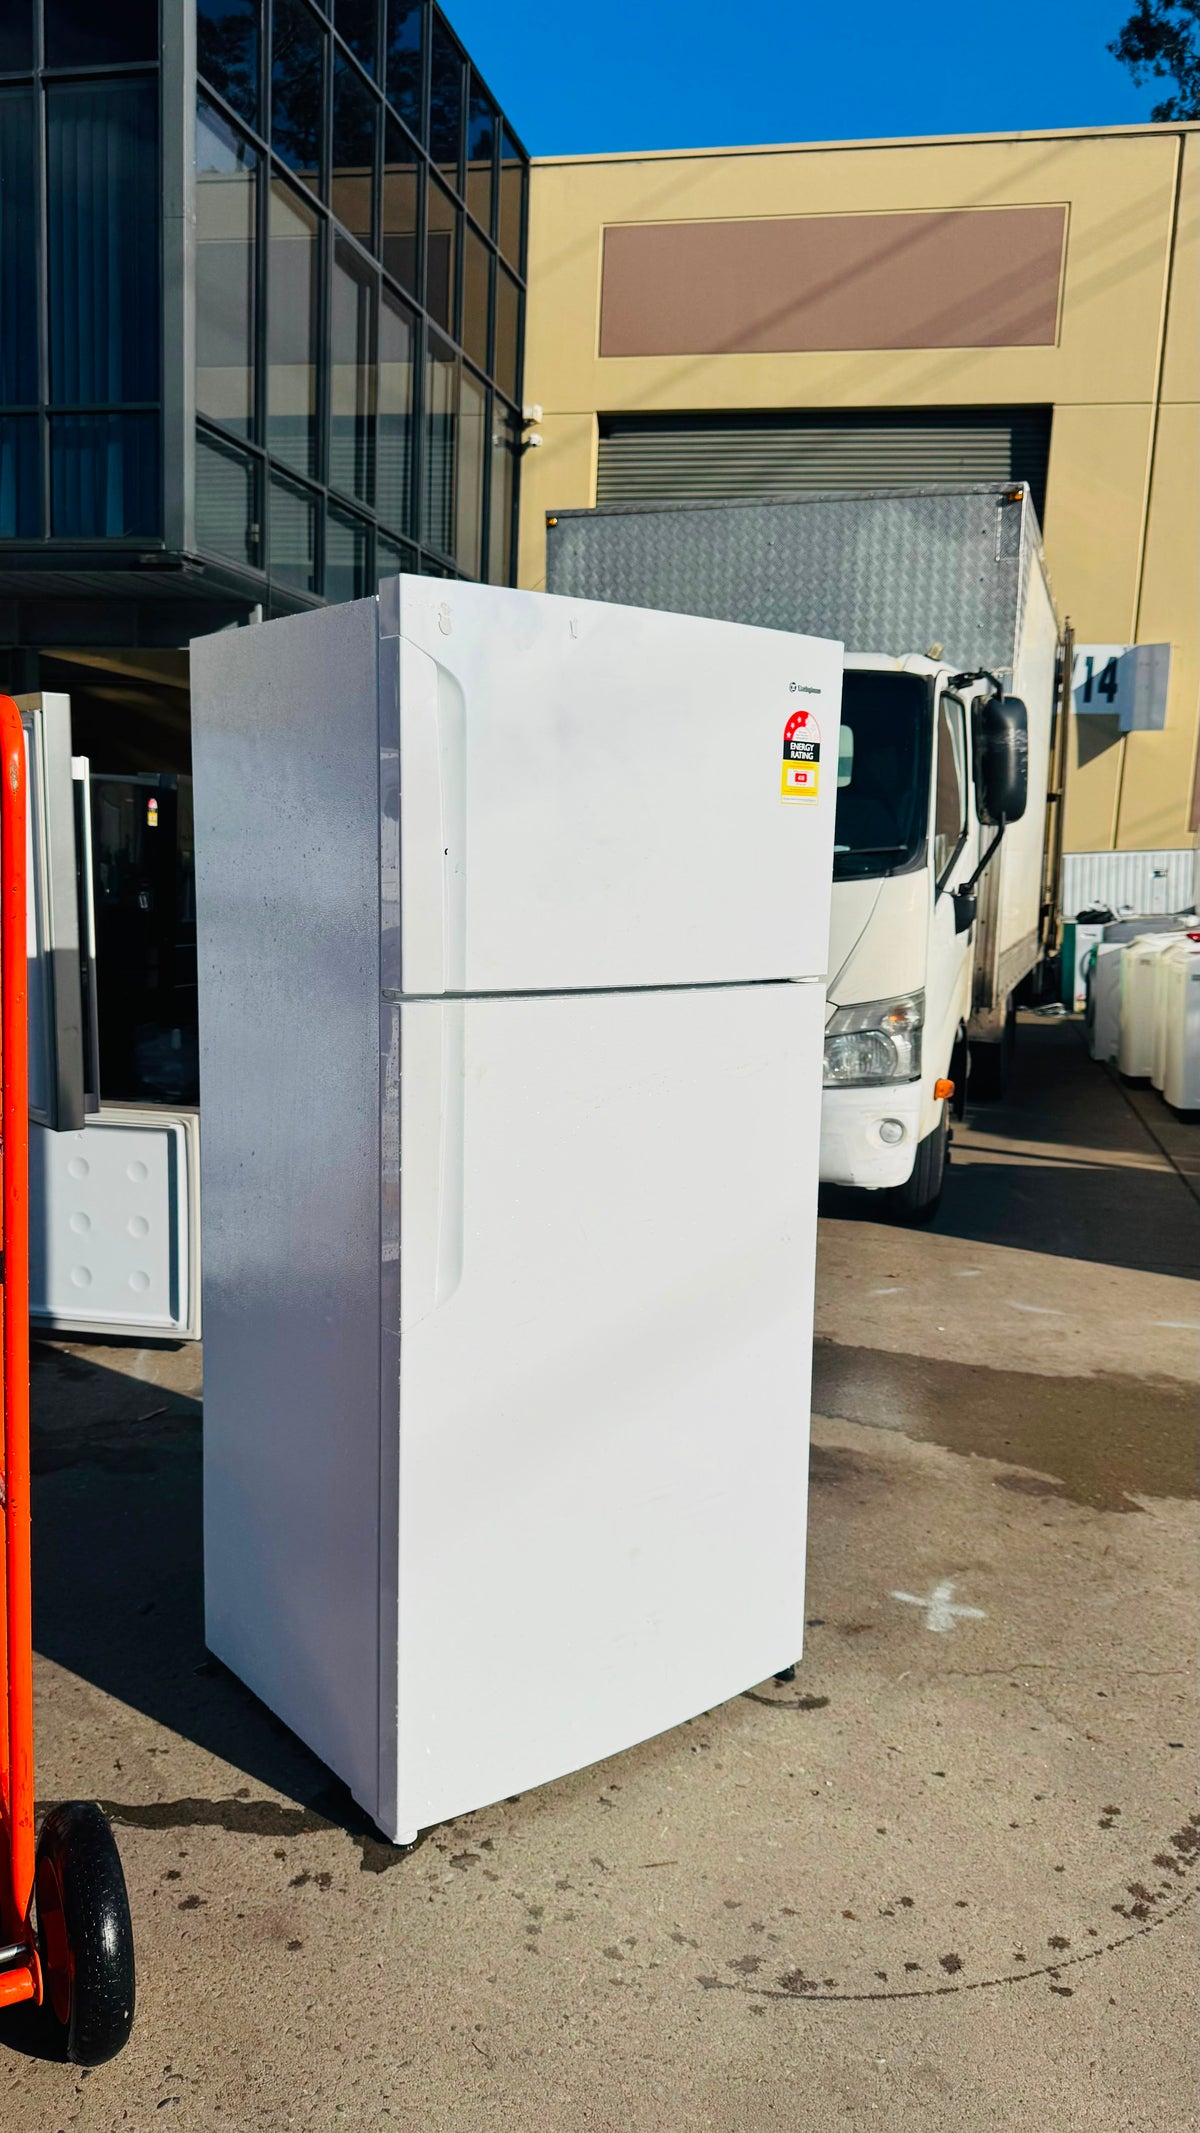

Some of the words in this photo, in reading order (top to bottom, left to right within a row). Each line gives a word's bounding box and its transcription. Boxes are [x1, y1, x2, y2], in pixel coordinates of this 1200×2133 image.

[1082, 656, 1119, 703] 14
[790, 742, 814, 751] ENERGY
[790, 751, 814, 760] RATING
